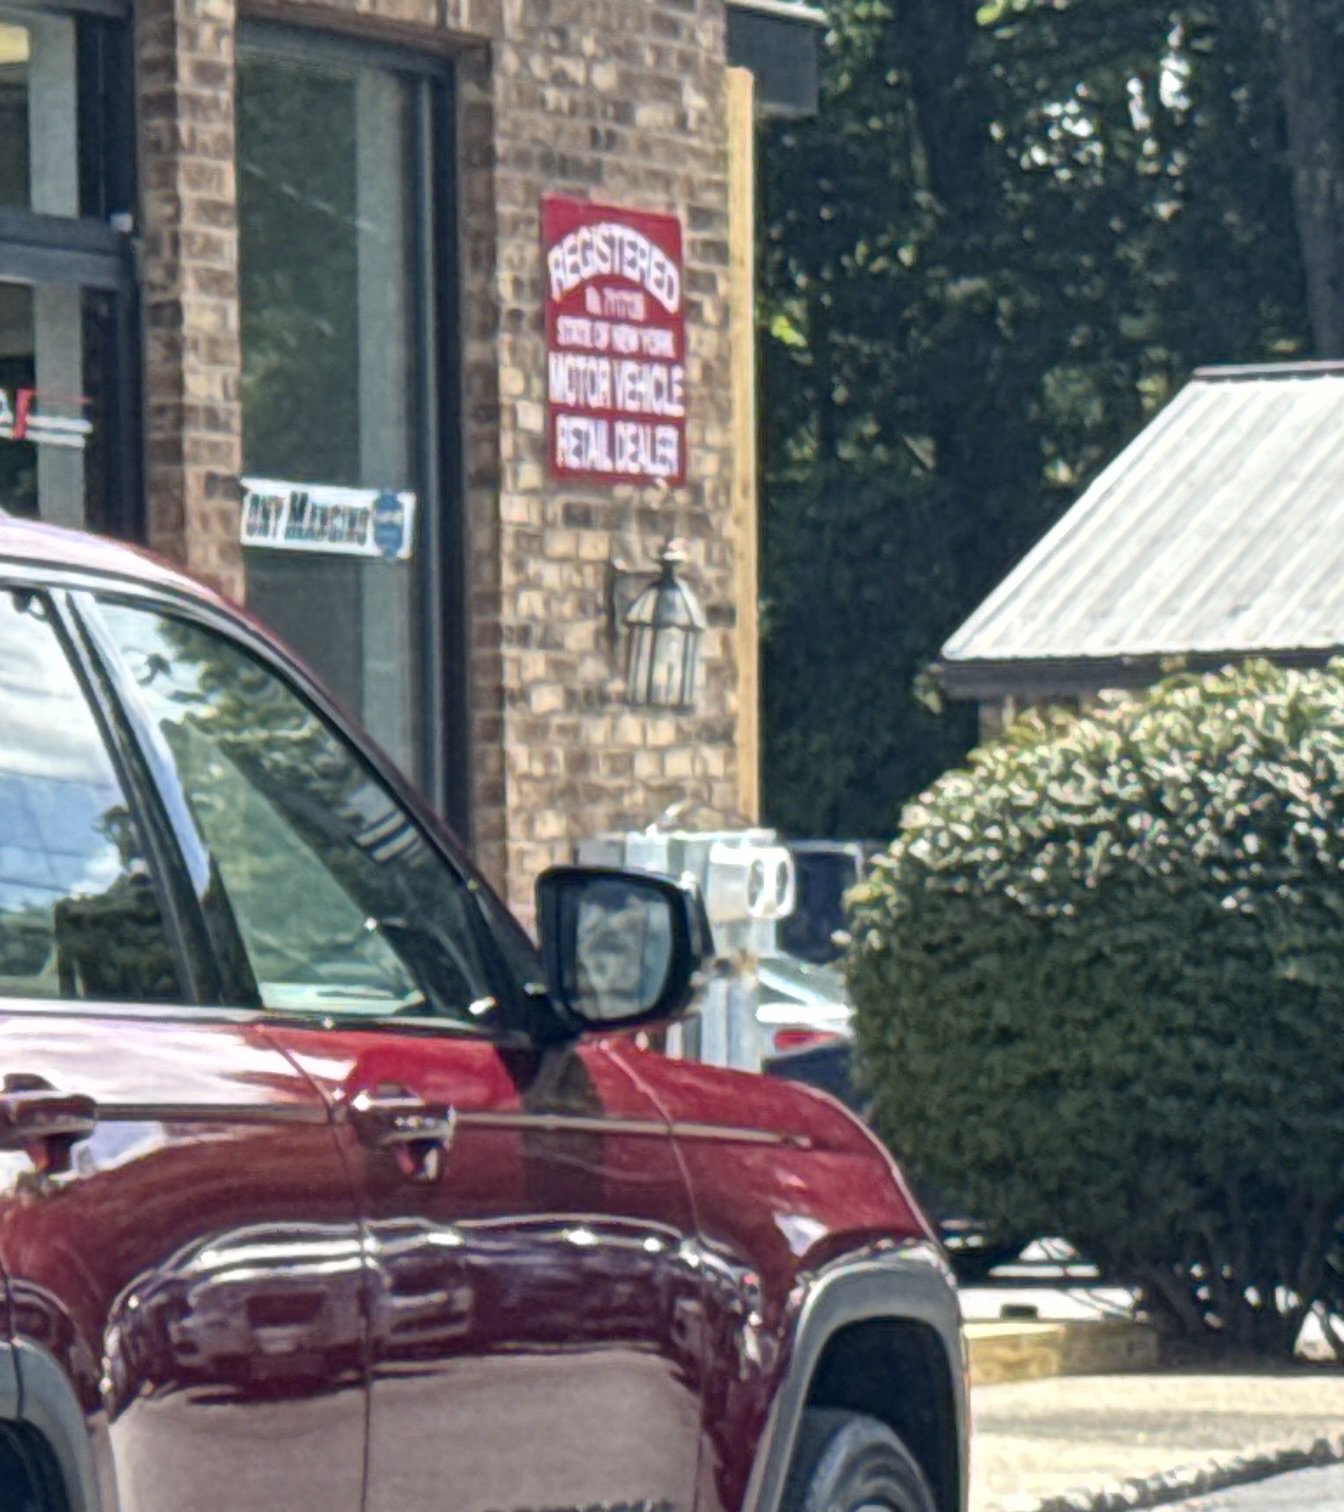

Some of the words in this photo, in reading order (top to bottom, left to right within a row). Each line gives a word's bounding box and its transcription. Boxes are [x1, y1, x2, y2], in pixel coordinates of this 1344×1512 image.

[547, 222, 680, 314] REGISTERED
[549, 351, 611, 409] MOTOR
[613, 358, 684, 417] VEHICLE
[556, 412, 613, 472] RETAIL
[614, 420, 679, 477] DEALER
